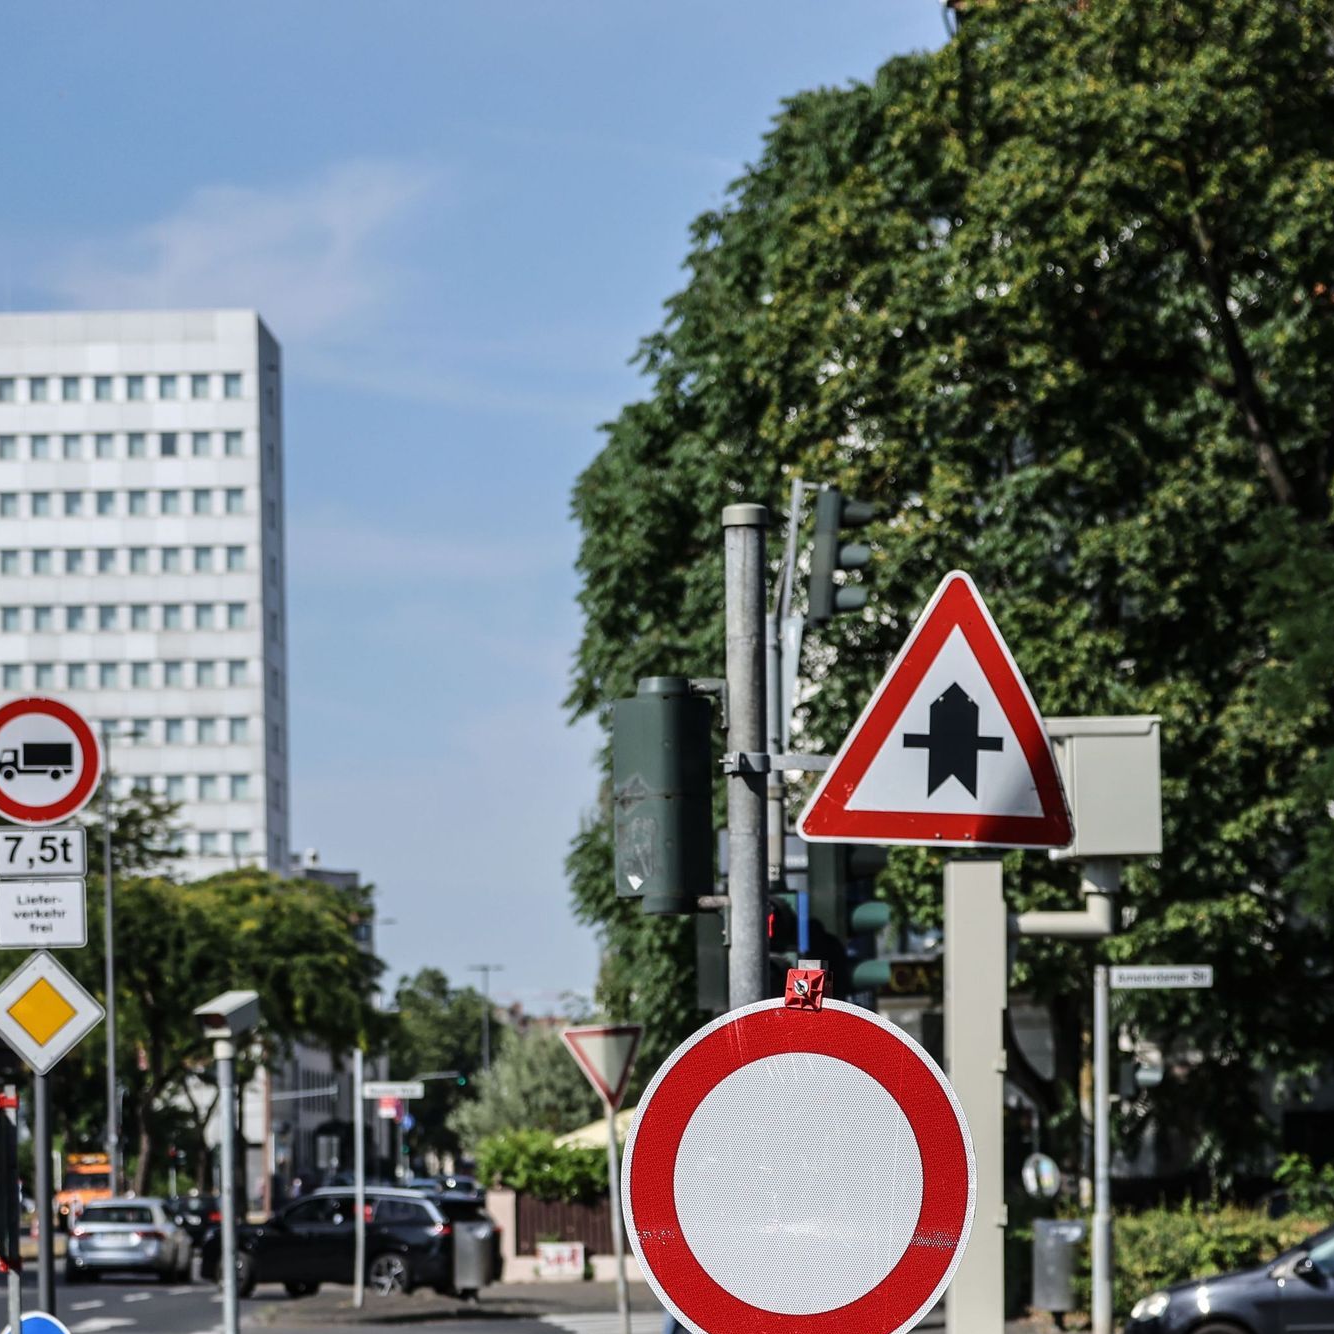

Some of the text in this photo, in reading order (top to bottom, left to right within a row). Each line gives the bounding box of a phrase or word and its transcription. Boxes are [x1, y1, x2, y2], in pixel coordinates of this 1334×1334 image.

[4, 836, 73, 869] 7,5t
[16, 894, 62, 906] Liefer-
[13, 909, 66, 920] verkehr
[29, 923, 53, 934] frei
